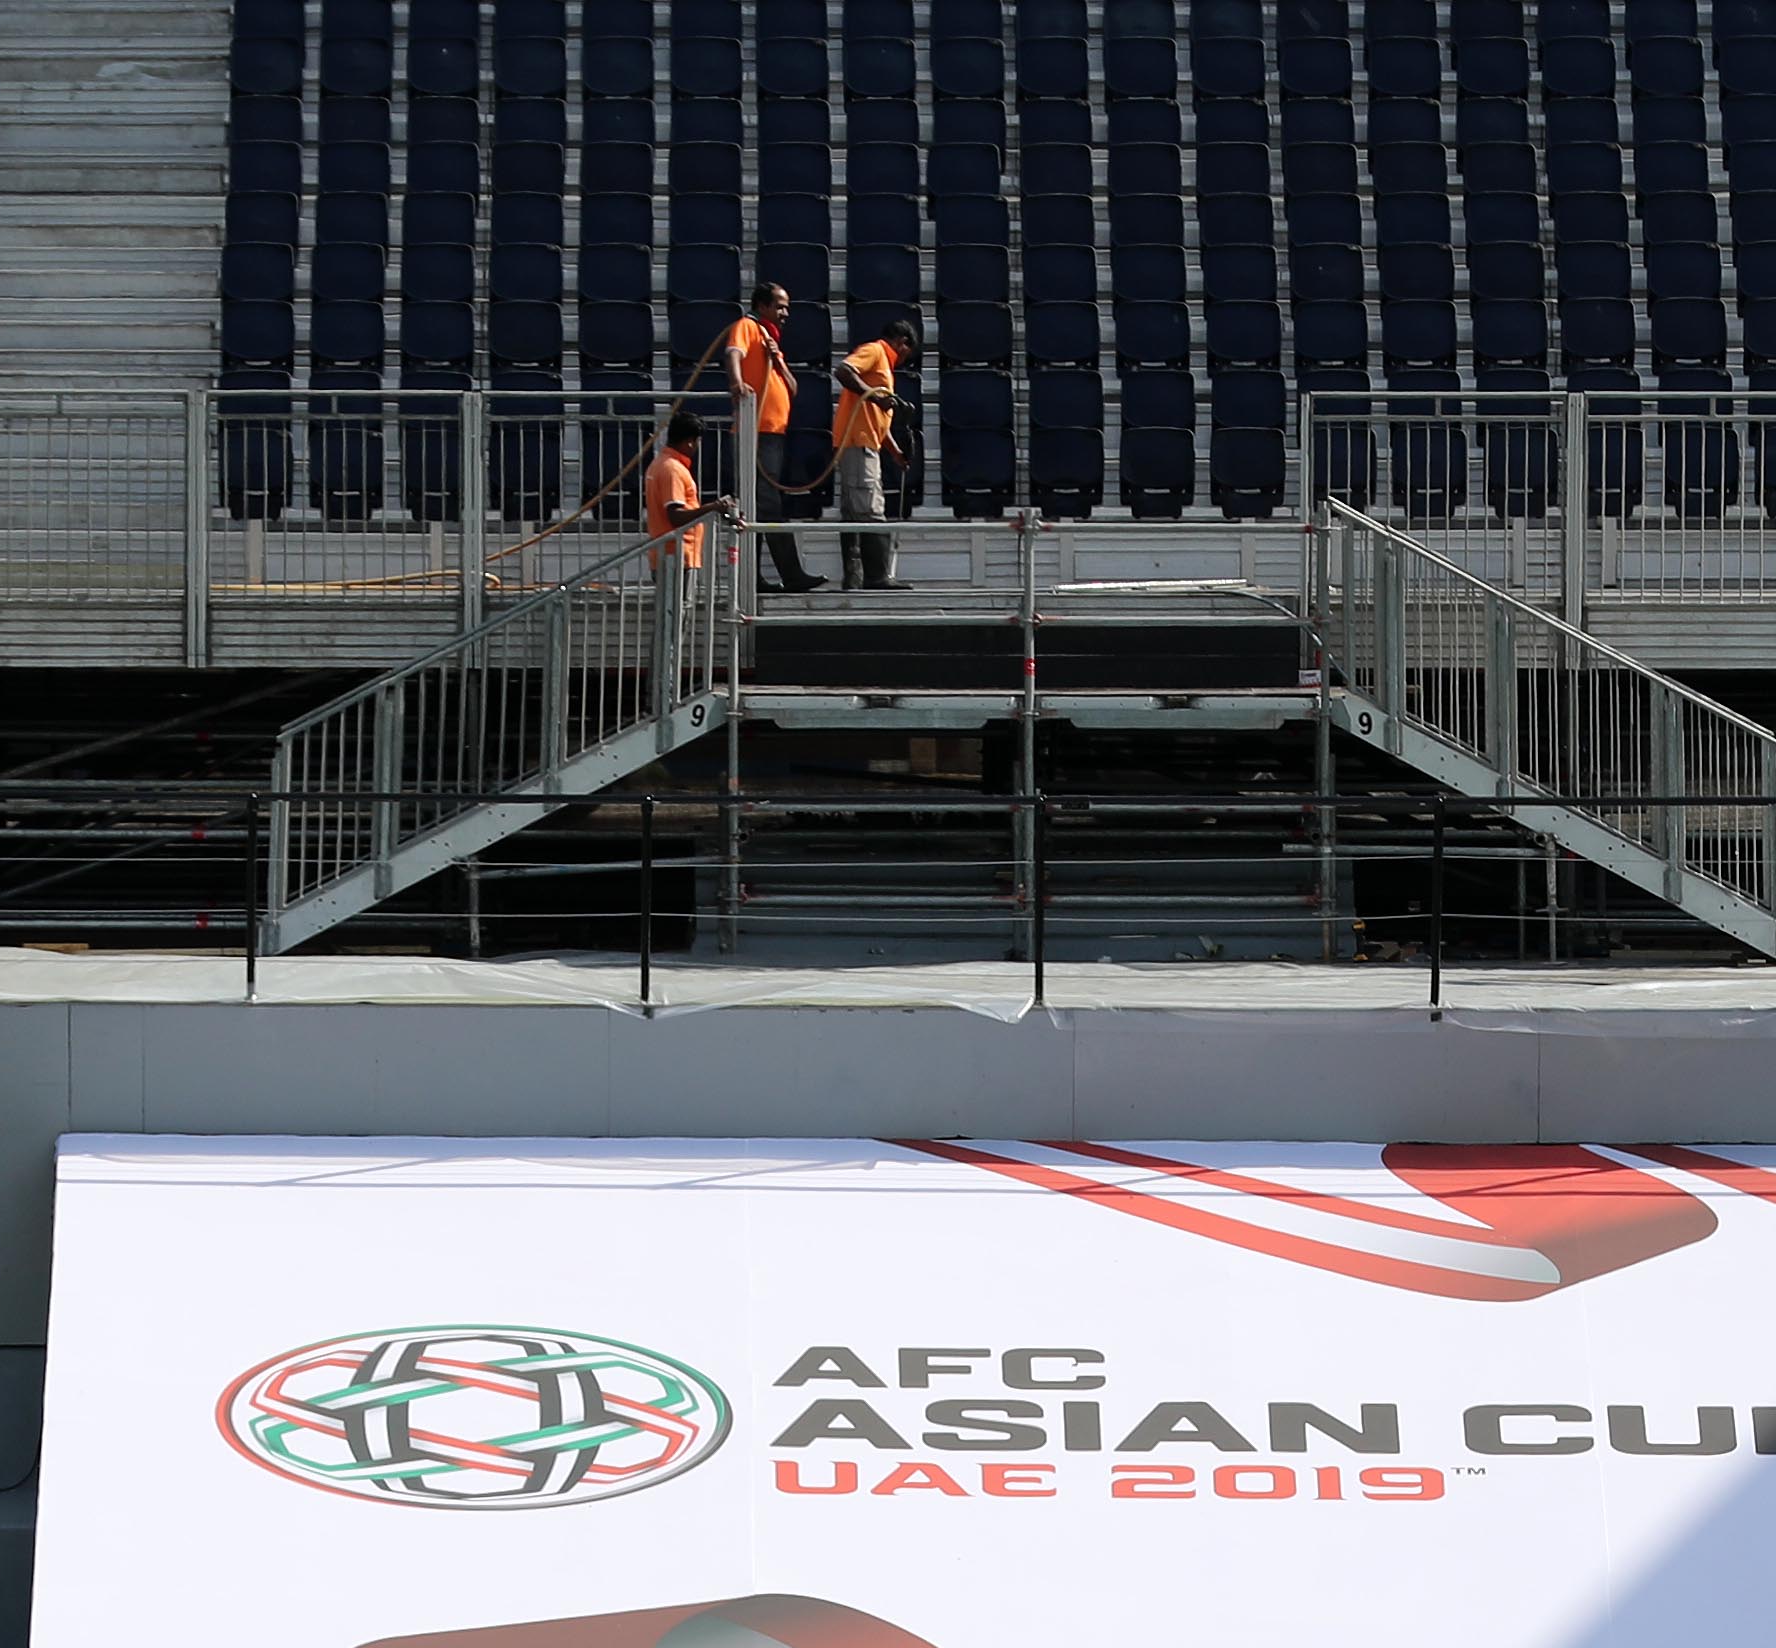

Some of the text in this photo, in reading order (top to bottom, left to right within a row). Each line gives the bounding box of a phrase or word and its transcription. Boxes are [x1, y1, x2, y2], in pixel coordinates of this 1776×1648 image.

[691, 704, 705, 728] 9
[1358, 712, 1373, 735] 9
[773, 1347, 1106, 1390] AFC
[771, 1399, 1400, 1454] ASIAN
[776, 1460, 1057, 1498] UAE
[1112, 1464, 1445, 1501] 2019
